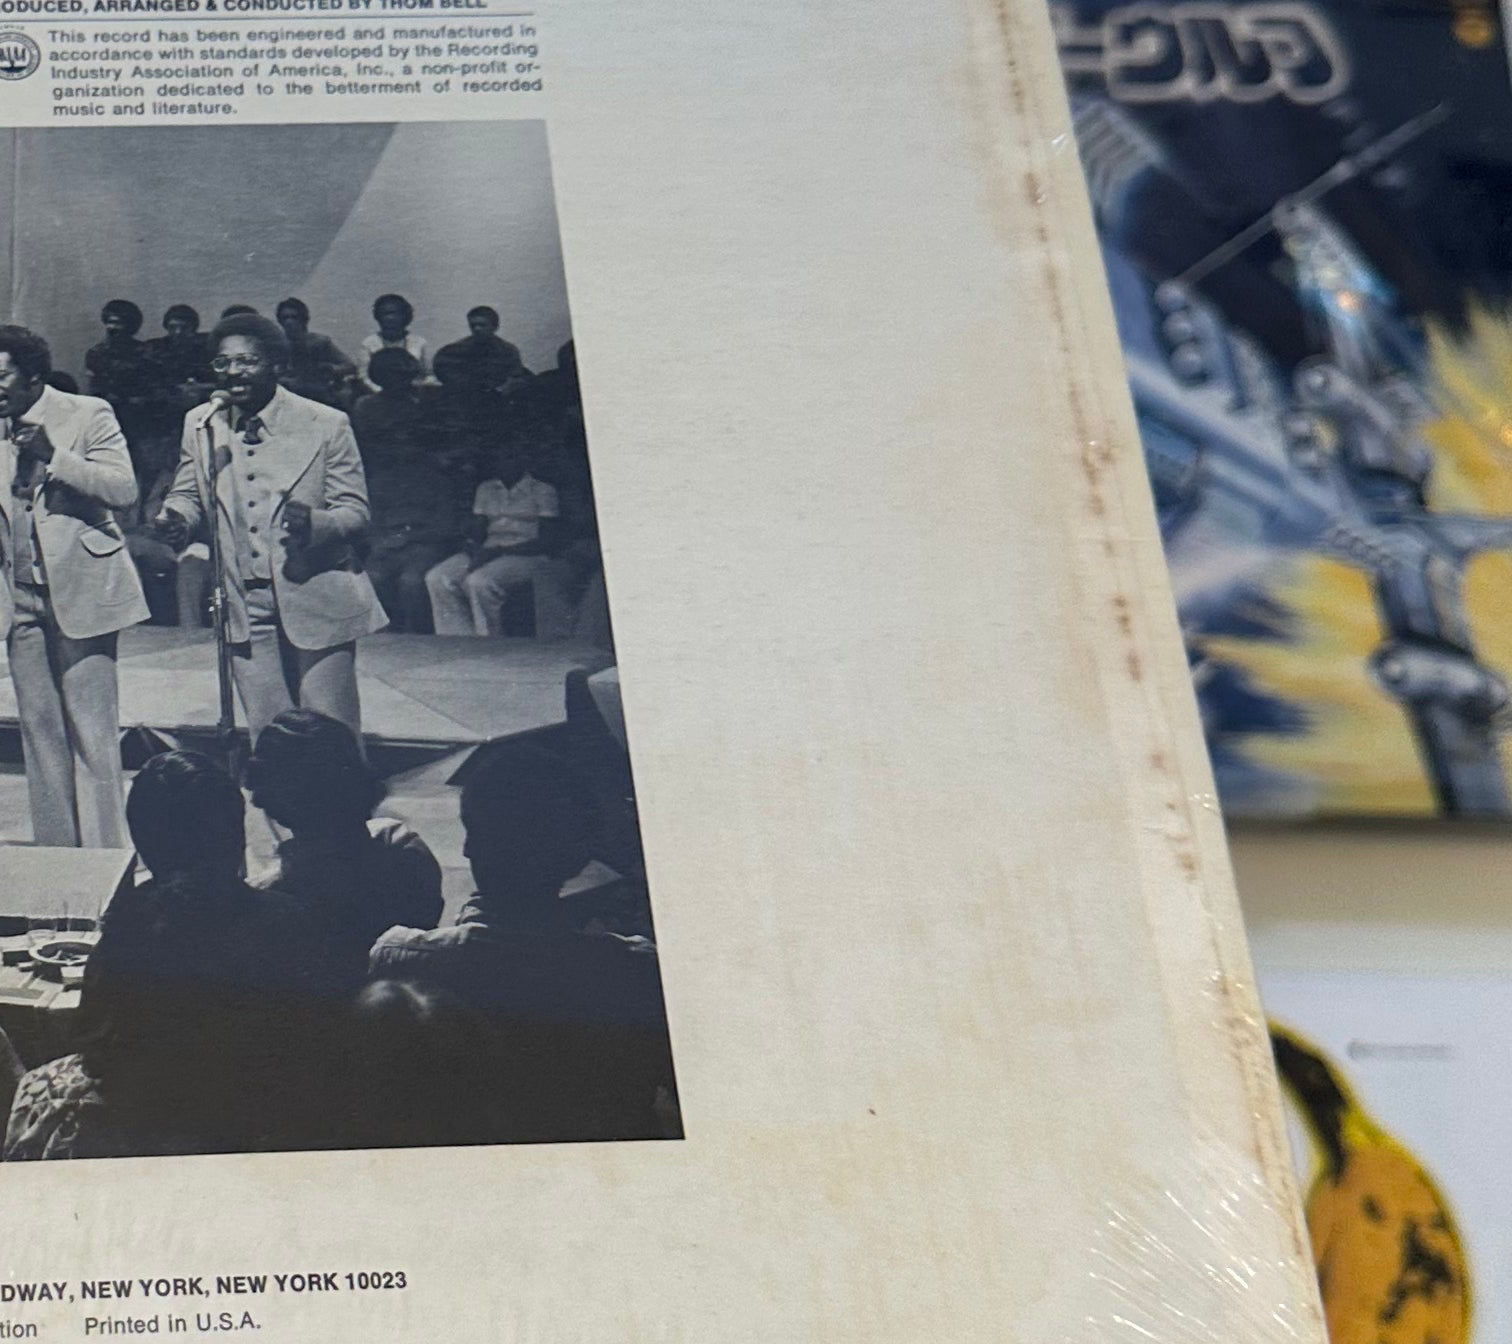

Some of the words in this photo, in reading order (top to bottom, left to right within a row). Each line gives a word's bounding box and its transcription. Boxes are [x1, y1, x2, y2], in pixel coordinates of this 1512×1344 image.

[94, 0, 199, 12] ARRANGED
[205, 0, 218, 12] &
[48, 30, 86, 43] This
[94, 29, 150, 43] record
[158, 29, 188, 42] has
[196, 29, 240, 42] been
[247, 28, 345, 43] engineered
[353, 27, 385, 40] and
[393, 25, 513, 40] manufactured
[520, 25, 536, 37] in
[49, 48, 153, 61] accordance
[158, 47, 194, 60] with
[199, 46, 287, 60] standards
[291, 45, 383, 60] developed
[389, 45, 410, 59] by
[415, 44, 442, 57] the
[447, 43, 538, 58] Recording
[51, 66, 122, 82] Industry
[131, 64, 233, 79] Association
[242, 64, 259, 77] of
[268, 64, 348, 78] America,
[401, 65, 413, 76] a
[421, 61, 507, 76] non-profit
[515, 62, 541, 74] or-
[52, 84, 145, 100] ganization
[157, 83, 244, 97] dedicated
[257, 84, 274, 96] to
[285, 82, 313, 96] the
[325, 80, 421, 94] betterment
[433, 79, 450, 93] of
[463, 79, 543, 93] recorded
[53, 103, 105, 116] music
[112, 102, 145, 115] and
[153, 100, 238, 115] literature.
[81, 1280, 132, 1300] NEW
[139, 1277, 211, 1300] YORK,
[217, 1276, 268, 1296] NEW
[274, 1273, 339, 1293] YORK
[345, 1271, 408, 1291] 10023
[85, 1315, 159, 1336] Printed
[167, 1315, 187, 1334] in
[196, 1312, 262, 1333] U.S.A.
